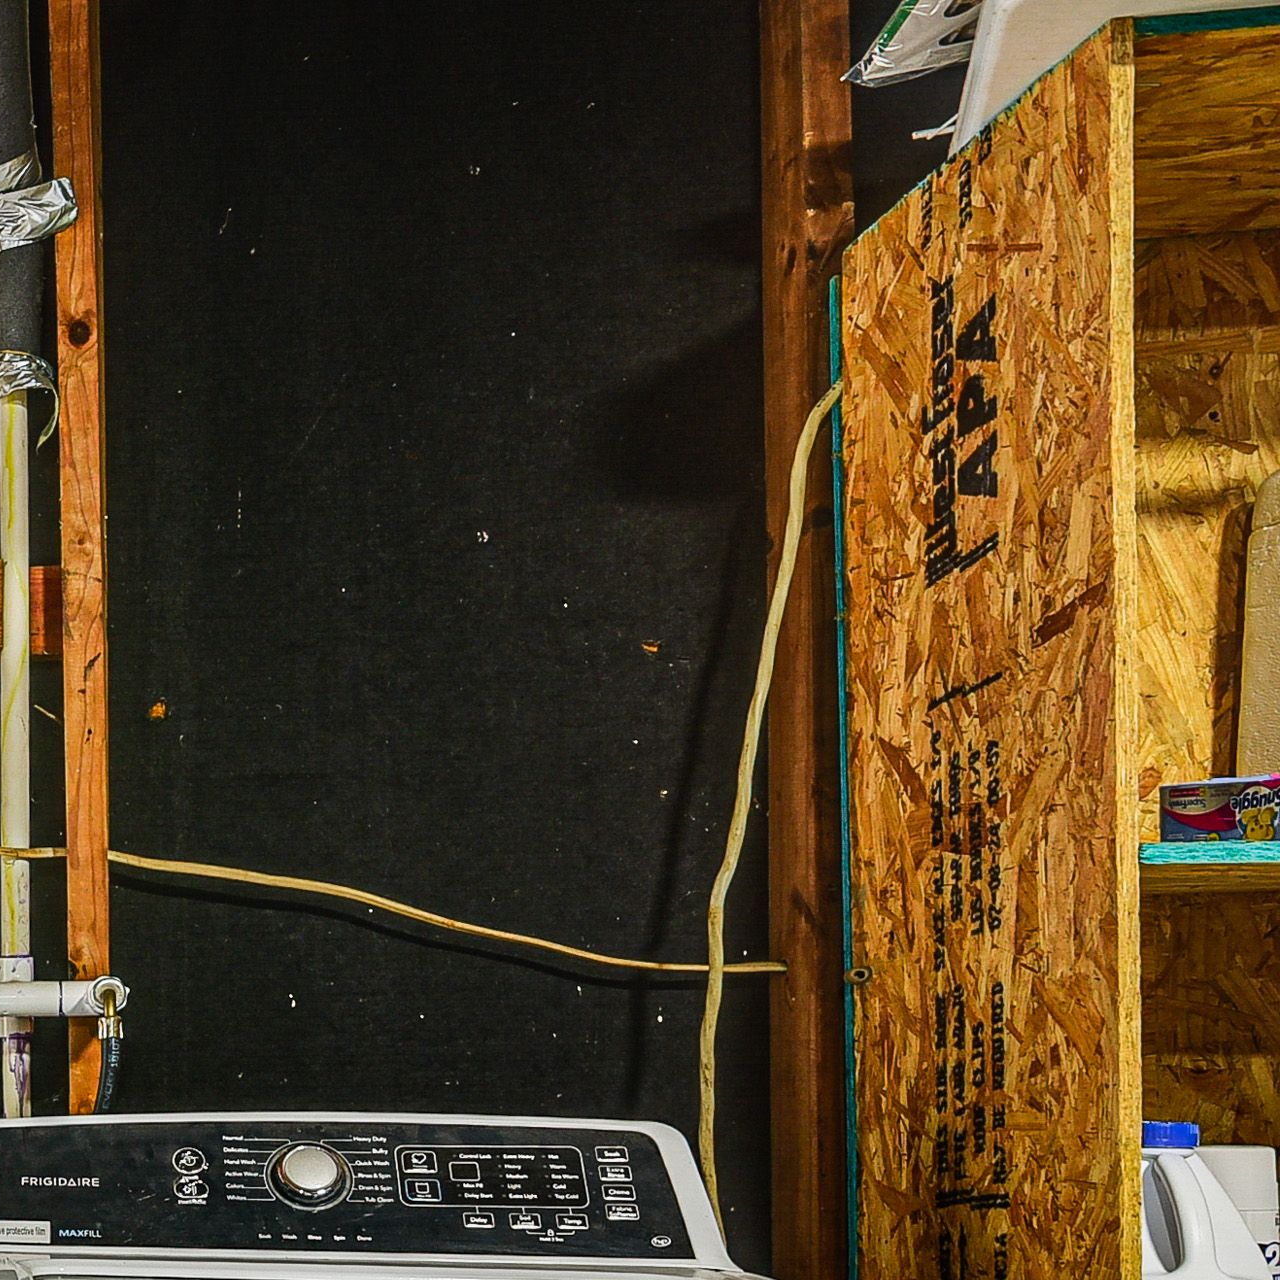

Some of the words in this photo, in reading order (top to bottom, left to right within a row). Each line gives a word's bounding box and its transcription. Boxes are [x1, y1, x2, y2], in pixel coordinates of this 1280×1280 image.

[956, 291, 998, 498] APA
[1231, 788, 1280, 814] Snuggle
[971, 1021, 986, 1090] CLIPS
[989, 981, 1006, 1090] REQUIRED
[935, 1062, 949, 1114] SIDE
[972, 1103, 987, 1154] ROOF
[991, 1104, 1006, 1131] BE
[21, 1176, 100, 1187] FRIGIDAIRE
[991, 1143, 1007, 1186] MAY
[5, 1226, 34, 1237] protective
[35, 1226, 46, 1236] film
[58, 1229, 102, 1238] MAXFILL
